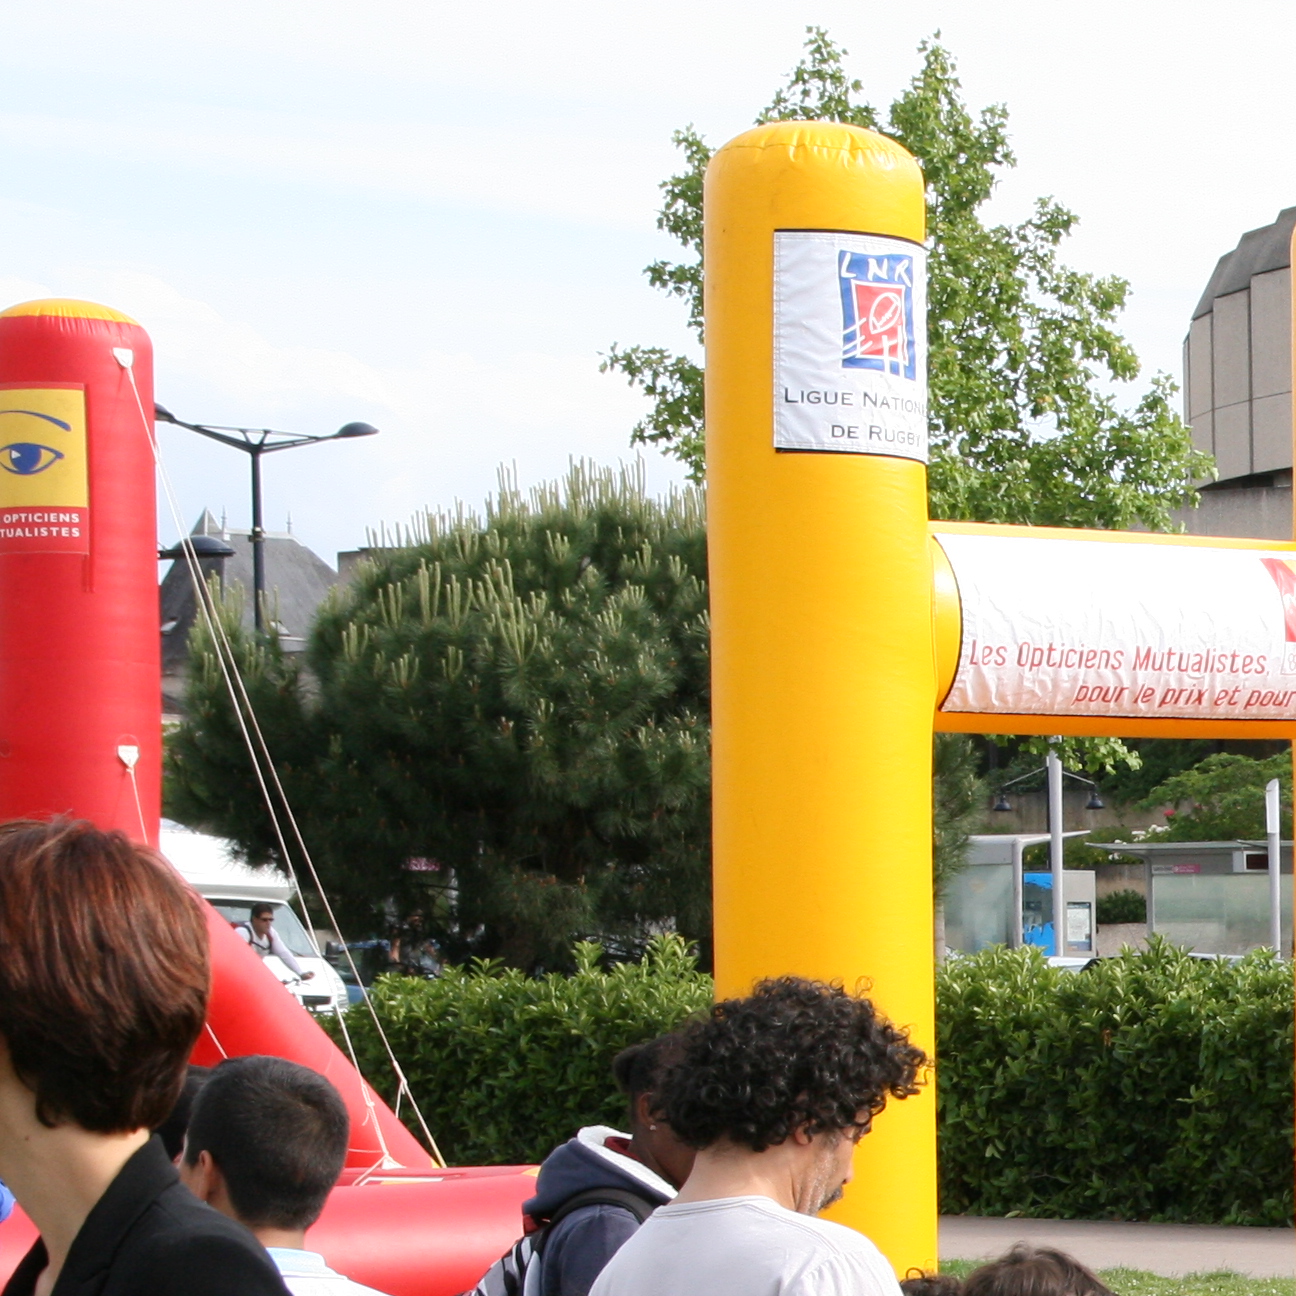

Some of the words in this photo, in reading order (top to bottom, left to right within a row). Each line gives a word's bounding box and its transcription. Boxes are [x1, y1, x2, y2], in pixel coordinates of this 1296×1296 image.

[784, 387, 854, 407] LIGUE
[831, 424, 859, 439] DE
[3, 512, 80, 524] OPTICIENS
[969, 639, 1007, 666] Les
[1016, 641, 1125, 672] Opticiens
[1132, 645, 1270, 677] Mutualistes,
[1071, 685, 1129, 707] pour
[1133, 683, 1155, 704] le
[1156, 684, 1208, 708] prix
[1214, 686, 1244, 706] et
